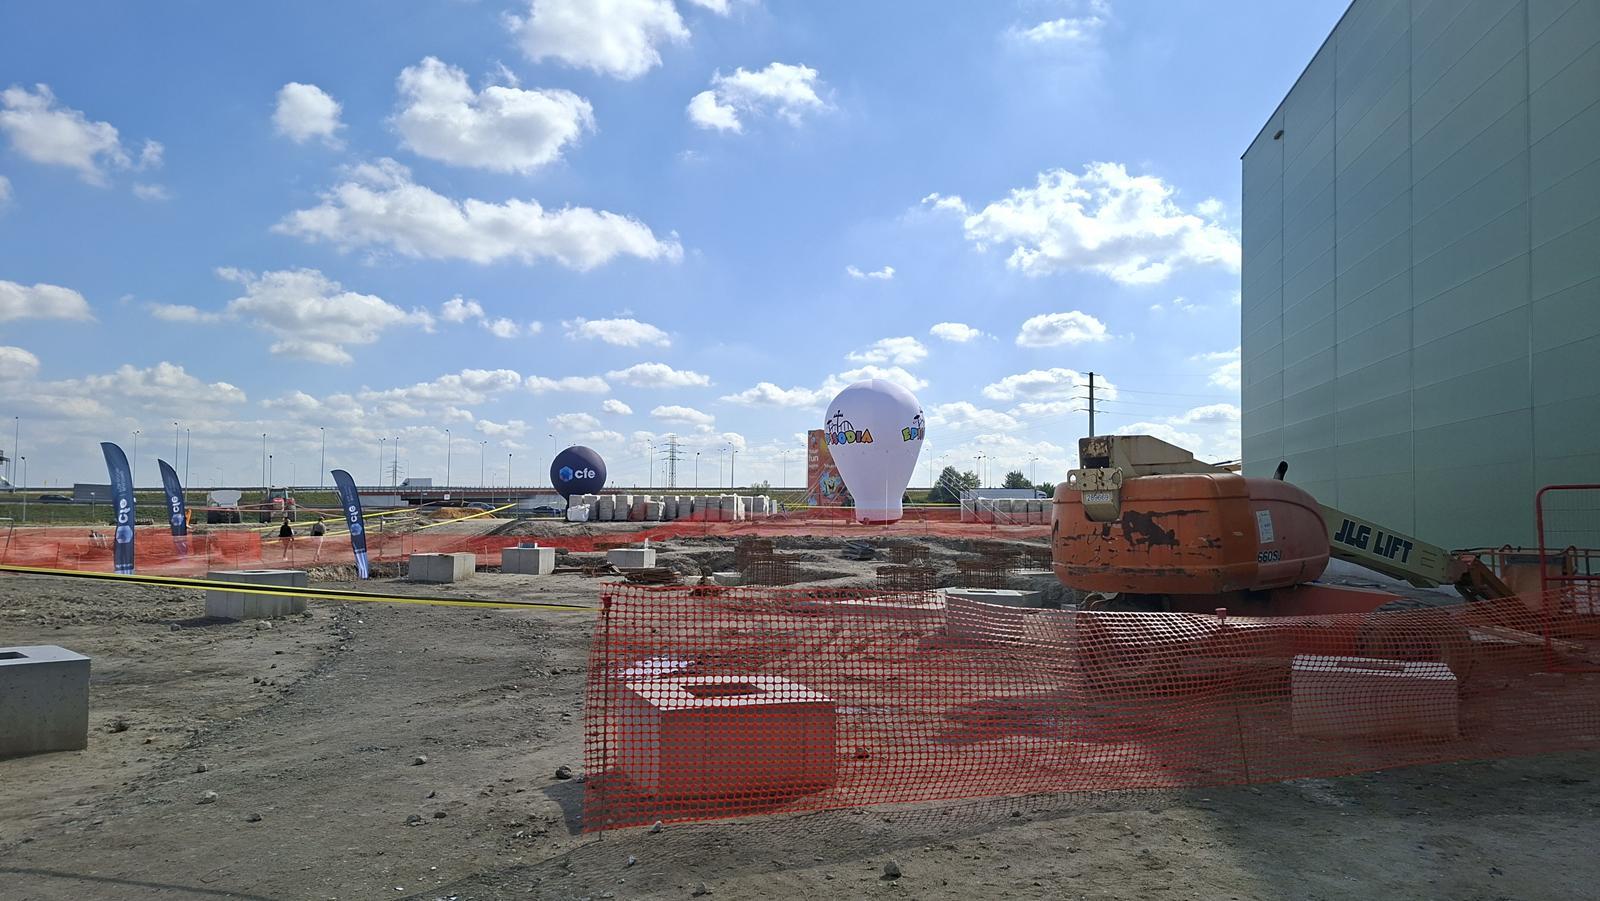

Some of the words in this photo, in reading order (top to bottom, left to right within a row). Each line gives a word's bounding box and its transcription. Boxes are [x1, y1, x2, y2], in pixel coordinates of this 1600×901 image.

[574, 467, 596, 479] cfe
[118, 498, 131, 524] cfe
[171, 495, 181, 513] cfe
[348, 505, 359, 523] cfe
[1334, 518, 1372, 550] JLG
[1373, 531, 1414, 564] LIFT
